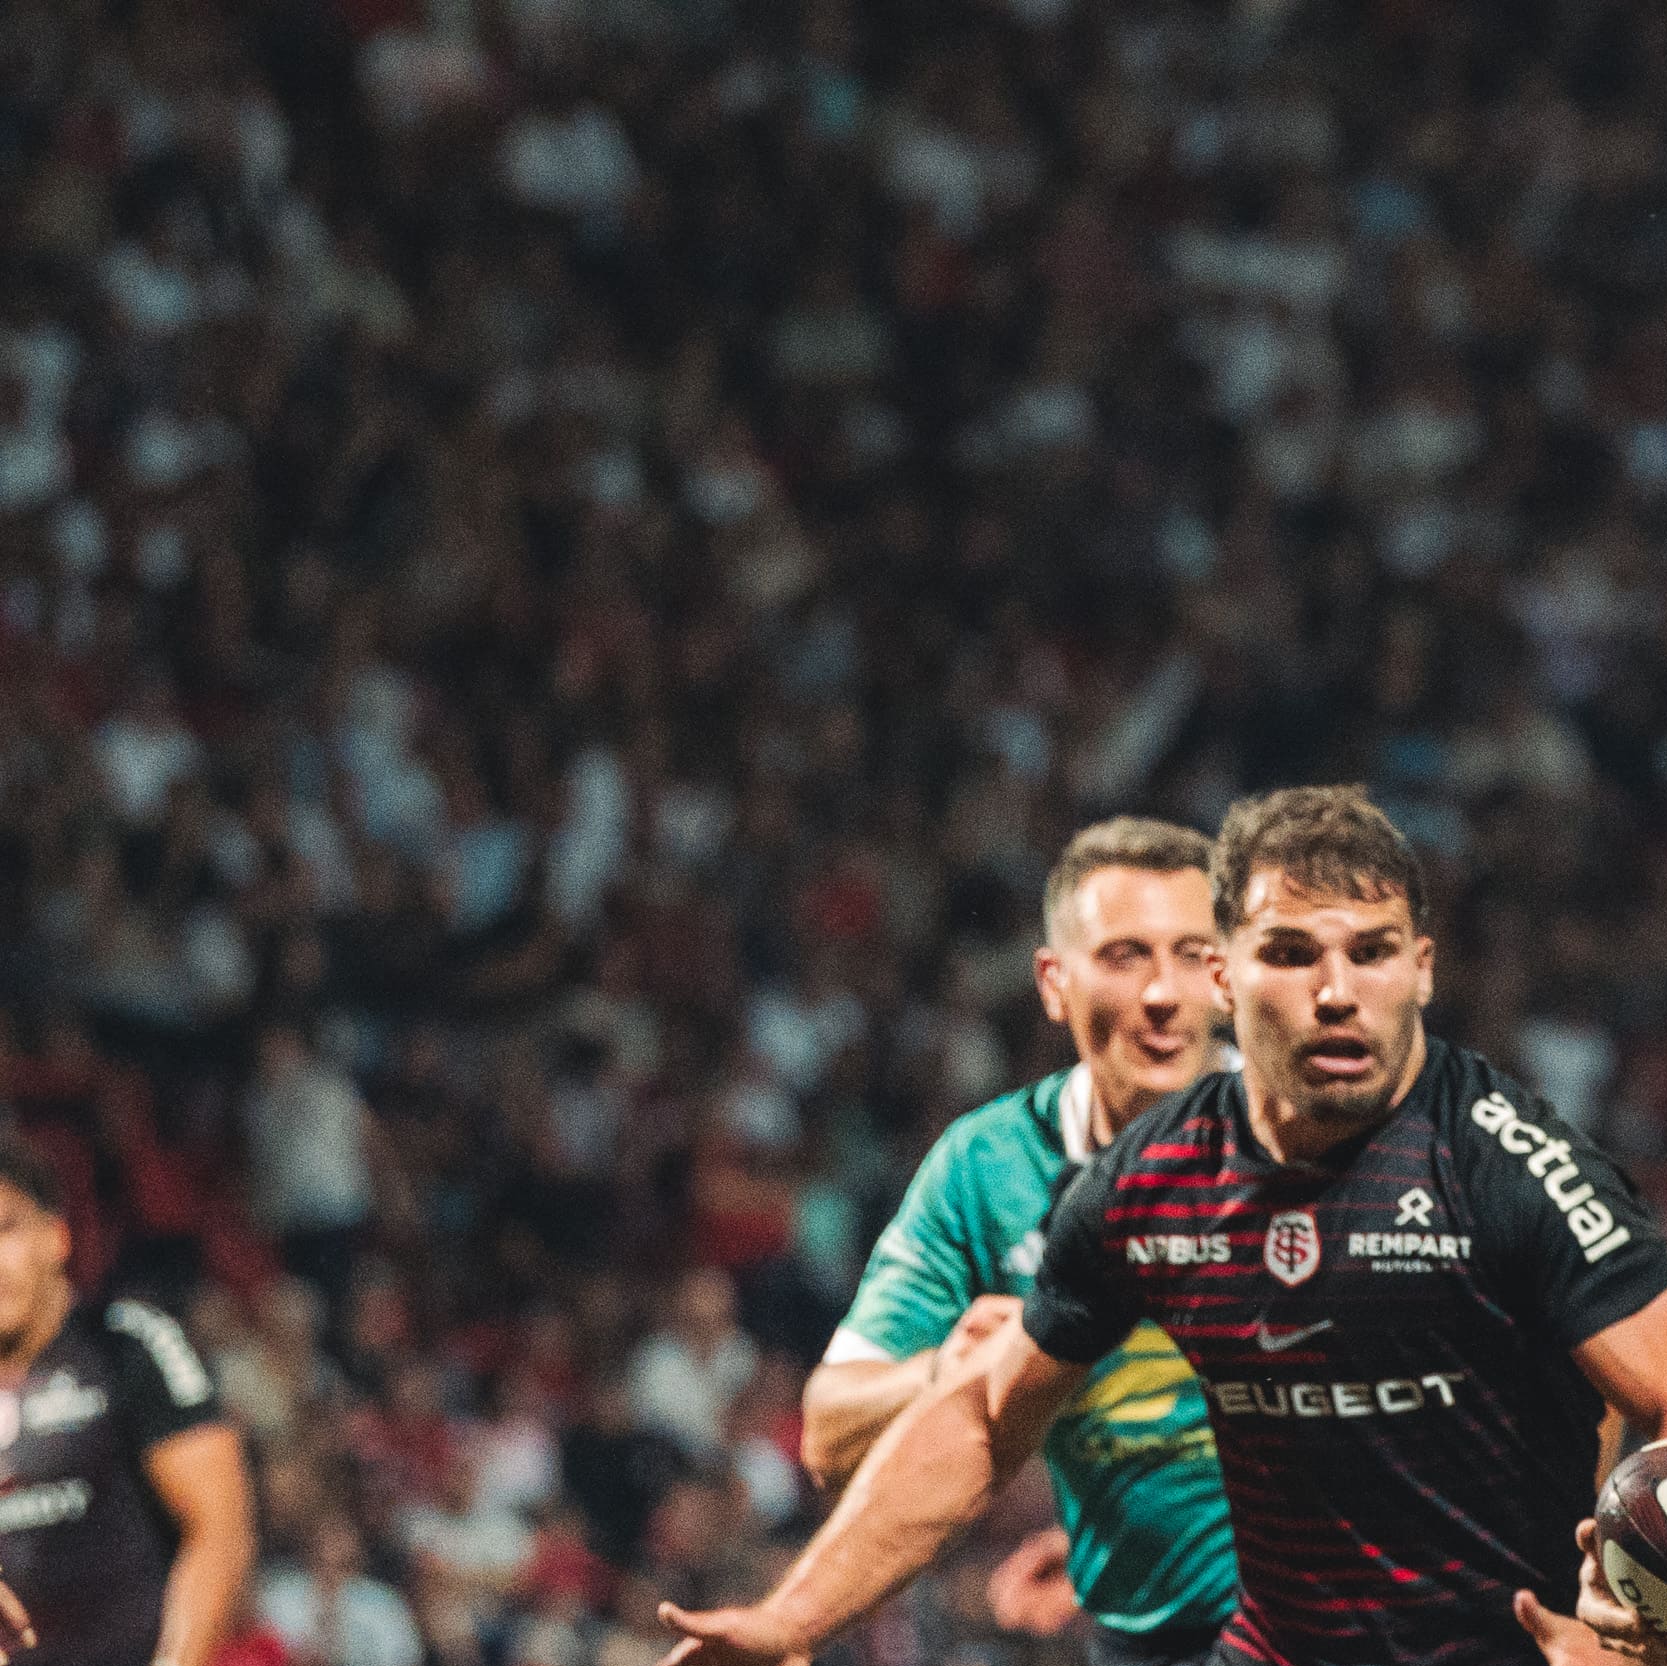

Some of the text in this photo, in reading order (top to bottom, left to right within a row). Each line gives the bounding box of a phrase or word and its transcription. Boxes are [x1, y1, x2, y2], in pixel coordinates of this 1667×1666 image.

[1470, 1090, 1630, 1265] actual
[1348, 1232, 1471, 1260] REMPART
[1203, 1374, 1464, 1417] EUGEOT
